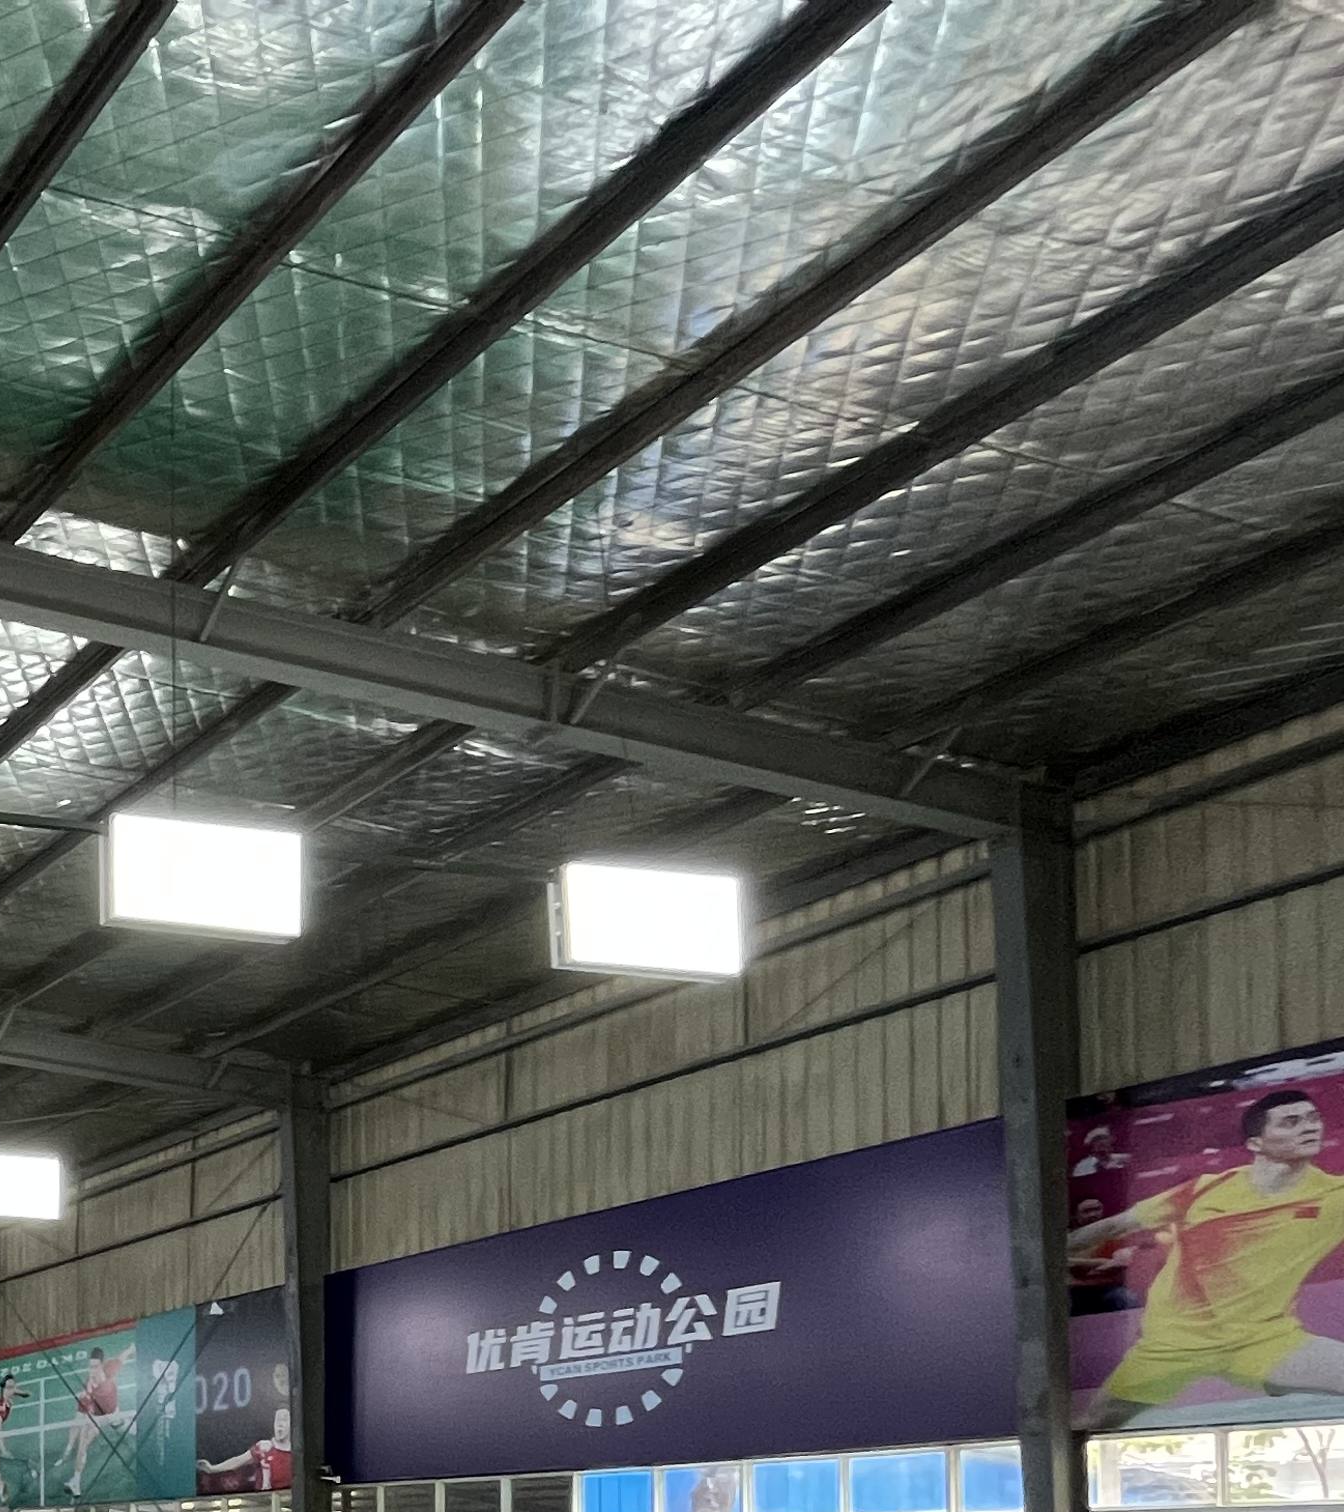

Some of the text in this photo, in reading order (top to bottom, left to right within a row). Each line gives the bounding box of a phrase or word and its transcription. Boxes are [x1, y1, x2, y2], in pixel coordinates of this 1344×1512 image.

[466, 1281, 781, 1374] 优肯运动公园
[584, 1358, 634, 1372] SPORTS
[636, 1351, 671, 1368] PARK
